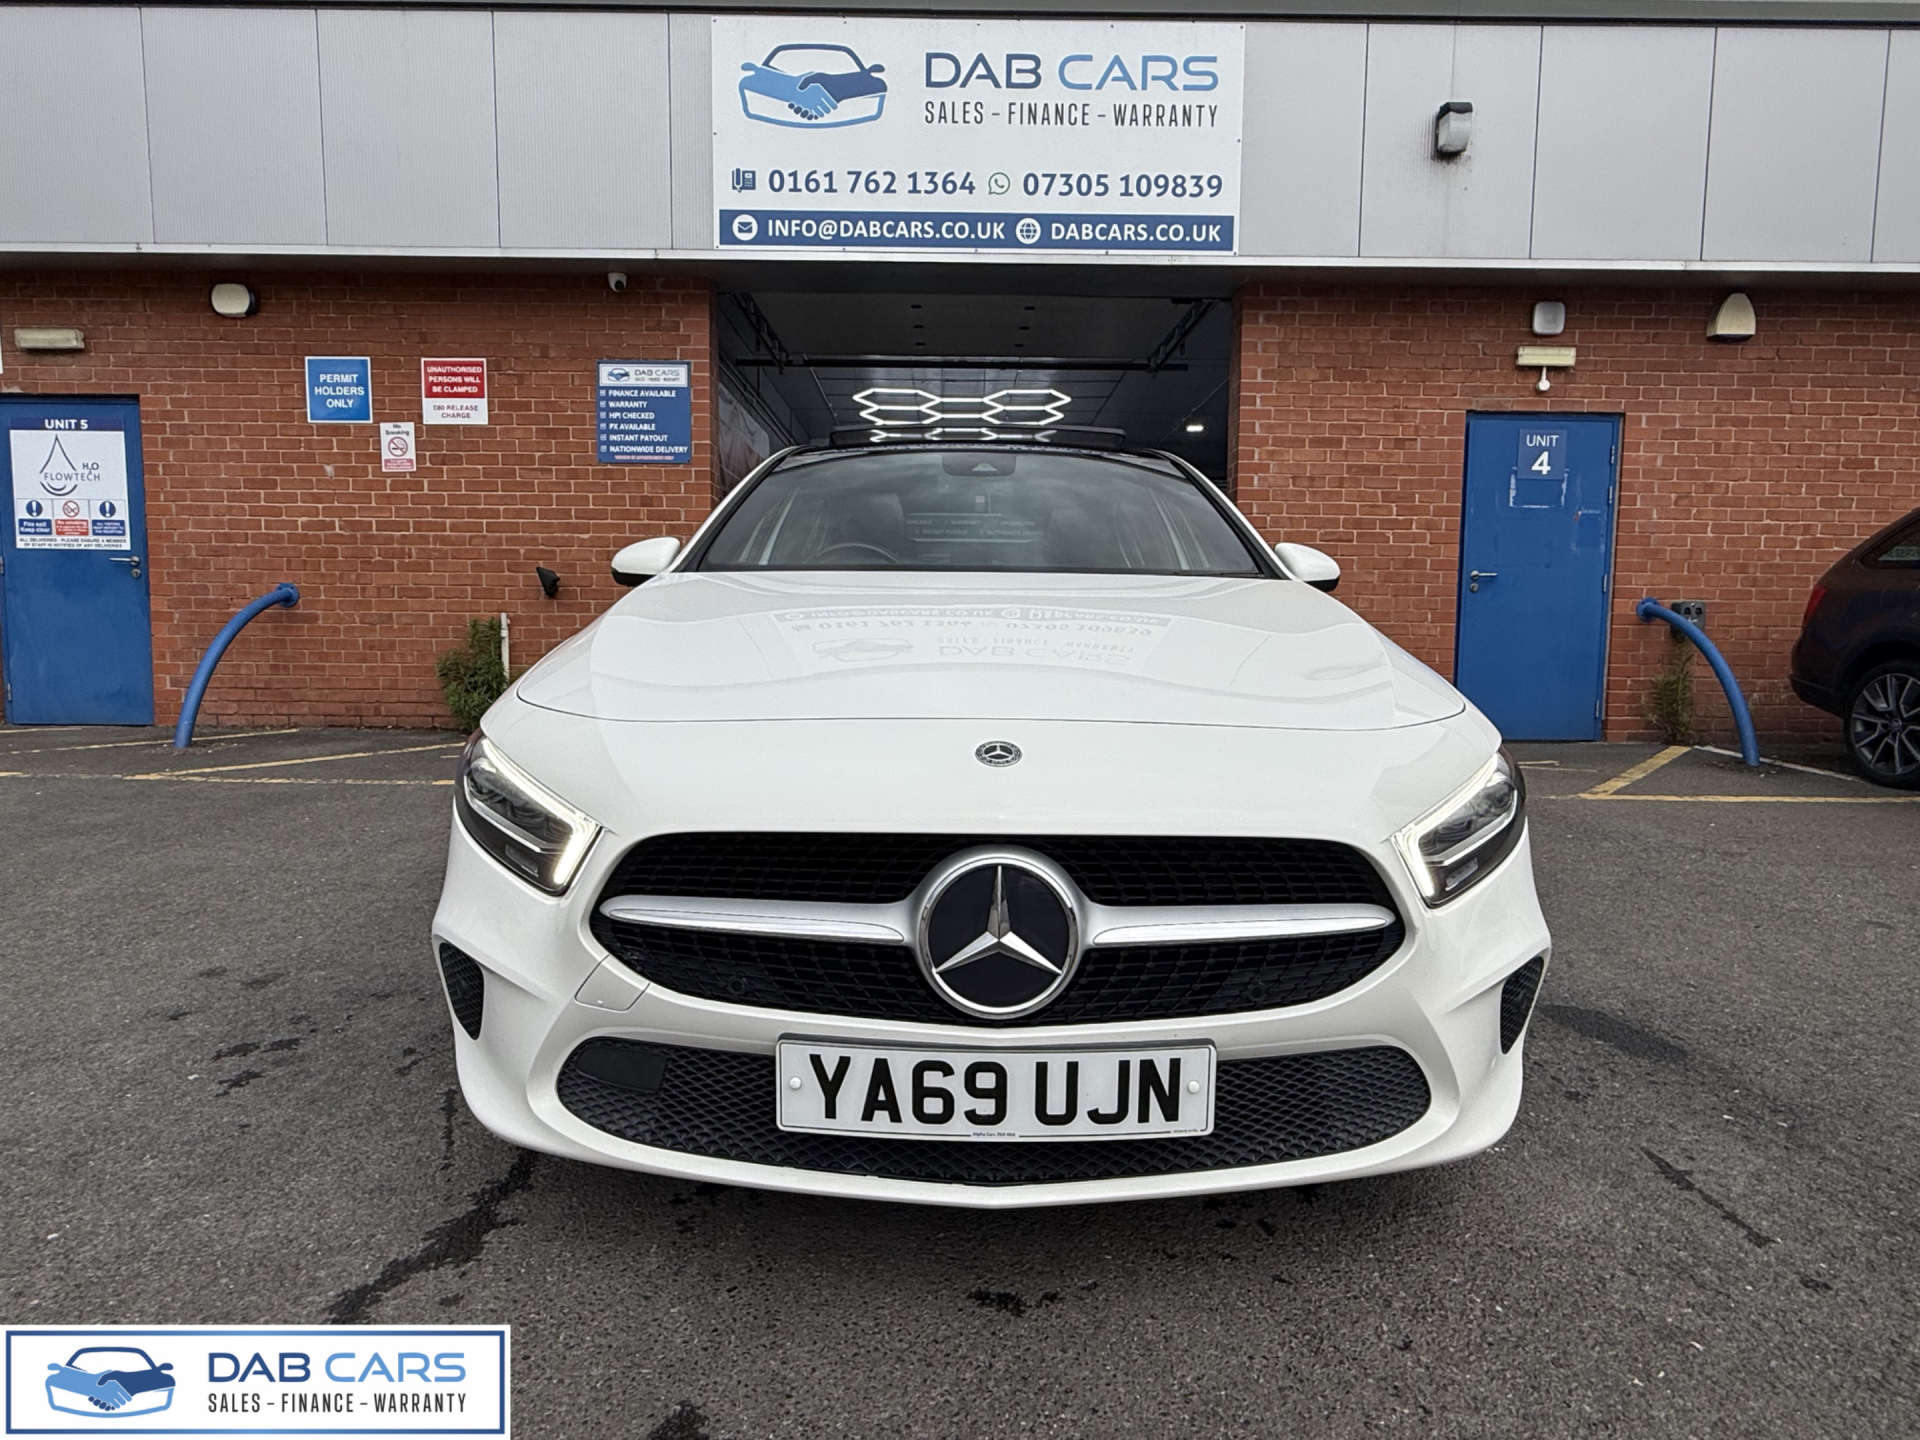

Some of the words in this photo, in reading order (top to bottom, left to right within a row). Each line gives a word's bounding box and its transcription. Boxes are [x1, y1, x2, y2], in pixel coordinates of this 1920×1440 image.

[925, 52, 1042, 89] DAB
[1058, 54, 1219, 91] CARS
[924, 101, 984, 125] SALES
[1008, 102, 1090, 126] FINANCE
[1113, 103, 1218, 128] WARRANTY
[768, 169, 838, 194] 0161
[847, 170, 897, 194] 762
[907, 170, 976, 195] 1364
[1023, 172, 1109, 196] 07305
[1119, 174, 1223, 198] 109839
[768, 219, 1005, 240] INFO@DABCARS.CO.UK
[1051, 223, 1221, 242] DABCARS.CO.UK
[319, 374, 358, 383] PERMIT
[314, 386, 365, 396] HOLDERS
[326, 398, 354, 408] ONLY
[44, 419, 78, 429] UNIT
[80, 420, 88, 430] 5
[1526, 434, 1559, 447] UNIT
[1531, 451, 1552, 475] 4
[44, 472, 100, 481] FLOWTECH
[809, 1054, 1008, 1126] YA69
[1034, 1058, 1182, 1126] UJN
